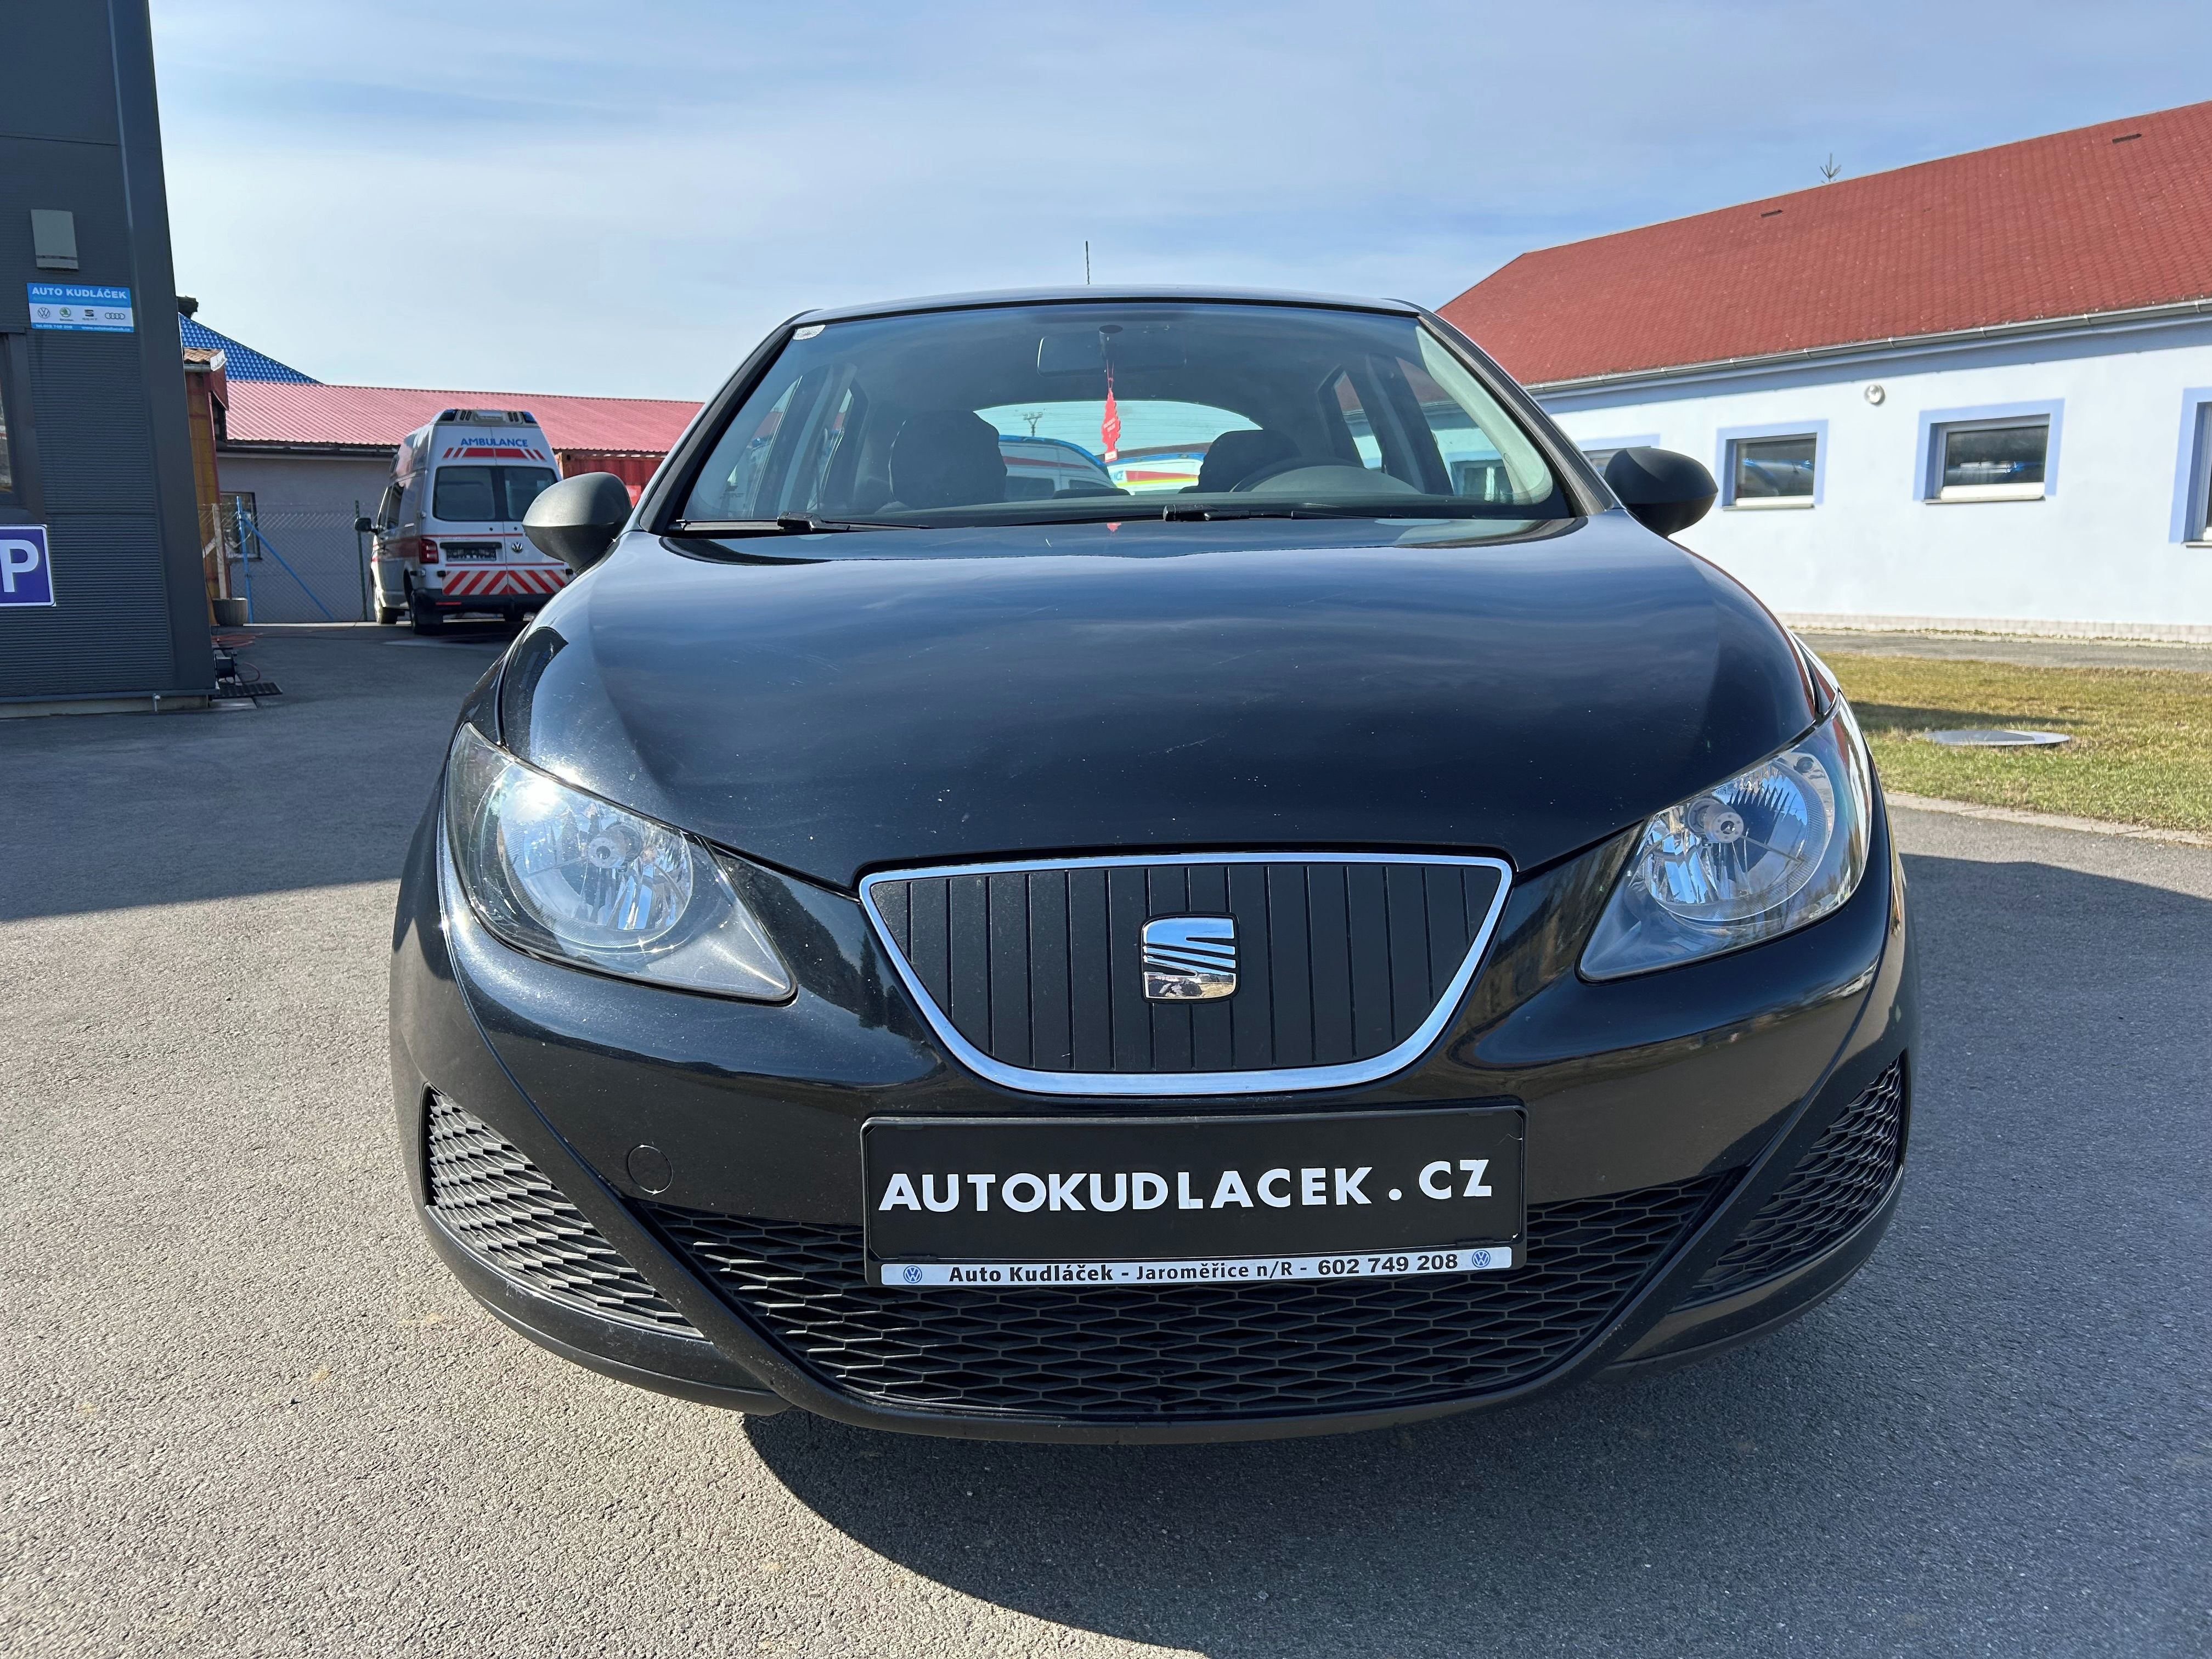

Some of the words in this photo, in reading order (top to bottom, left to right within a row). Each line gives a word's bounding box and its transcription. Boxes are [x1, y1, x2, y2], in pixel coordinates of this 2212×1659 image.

[32, 287, 63, 296] AUTO
[66, 288, 127, 299] KUDLÁČEK
[461, 438, 528, 447] AMBULANCE
[0, 539, 39, 592] P
[949, 1266, 1001, 1282] Auto
[1009, 1264, 1113, 1282] Kudláček
[1136, 1262, 1249, 1280] Jaroměřice
[1257, 1261, 1293, 1279] n/R
[1318, 1259, 1359, 1276] 602
[1368, 1256, 1409, 1273] 749
[1417, 1254, 1458, 1271] 208
